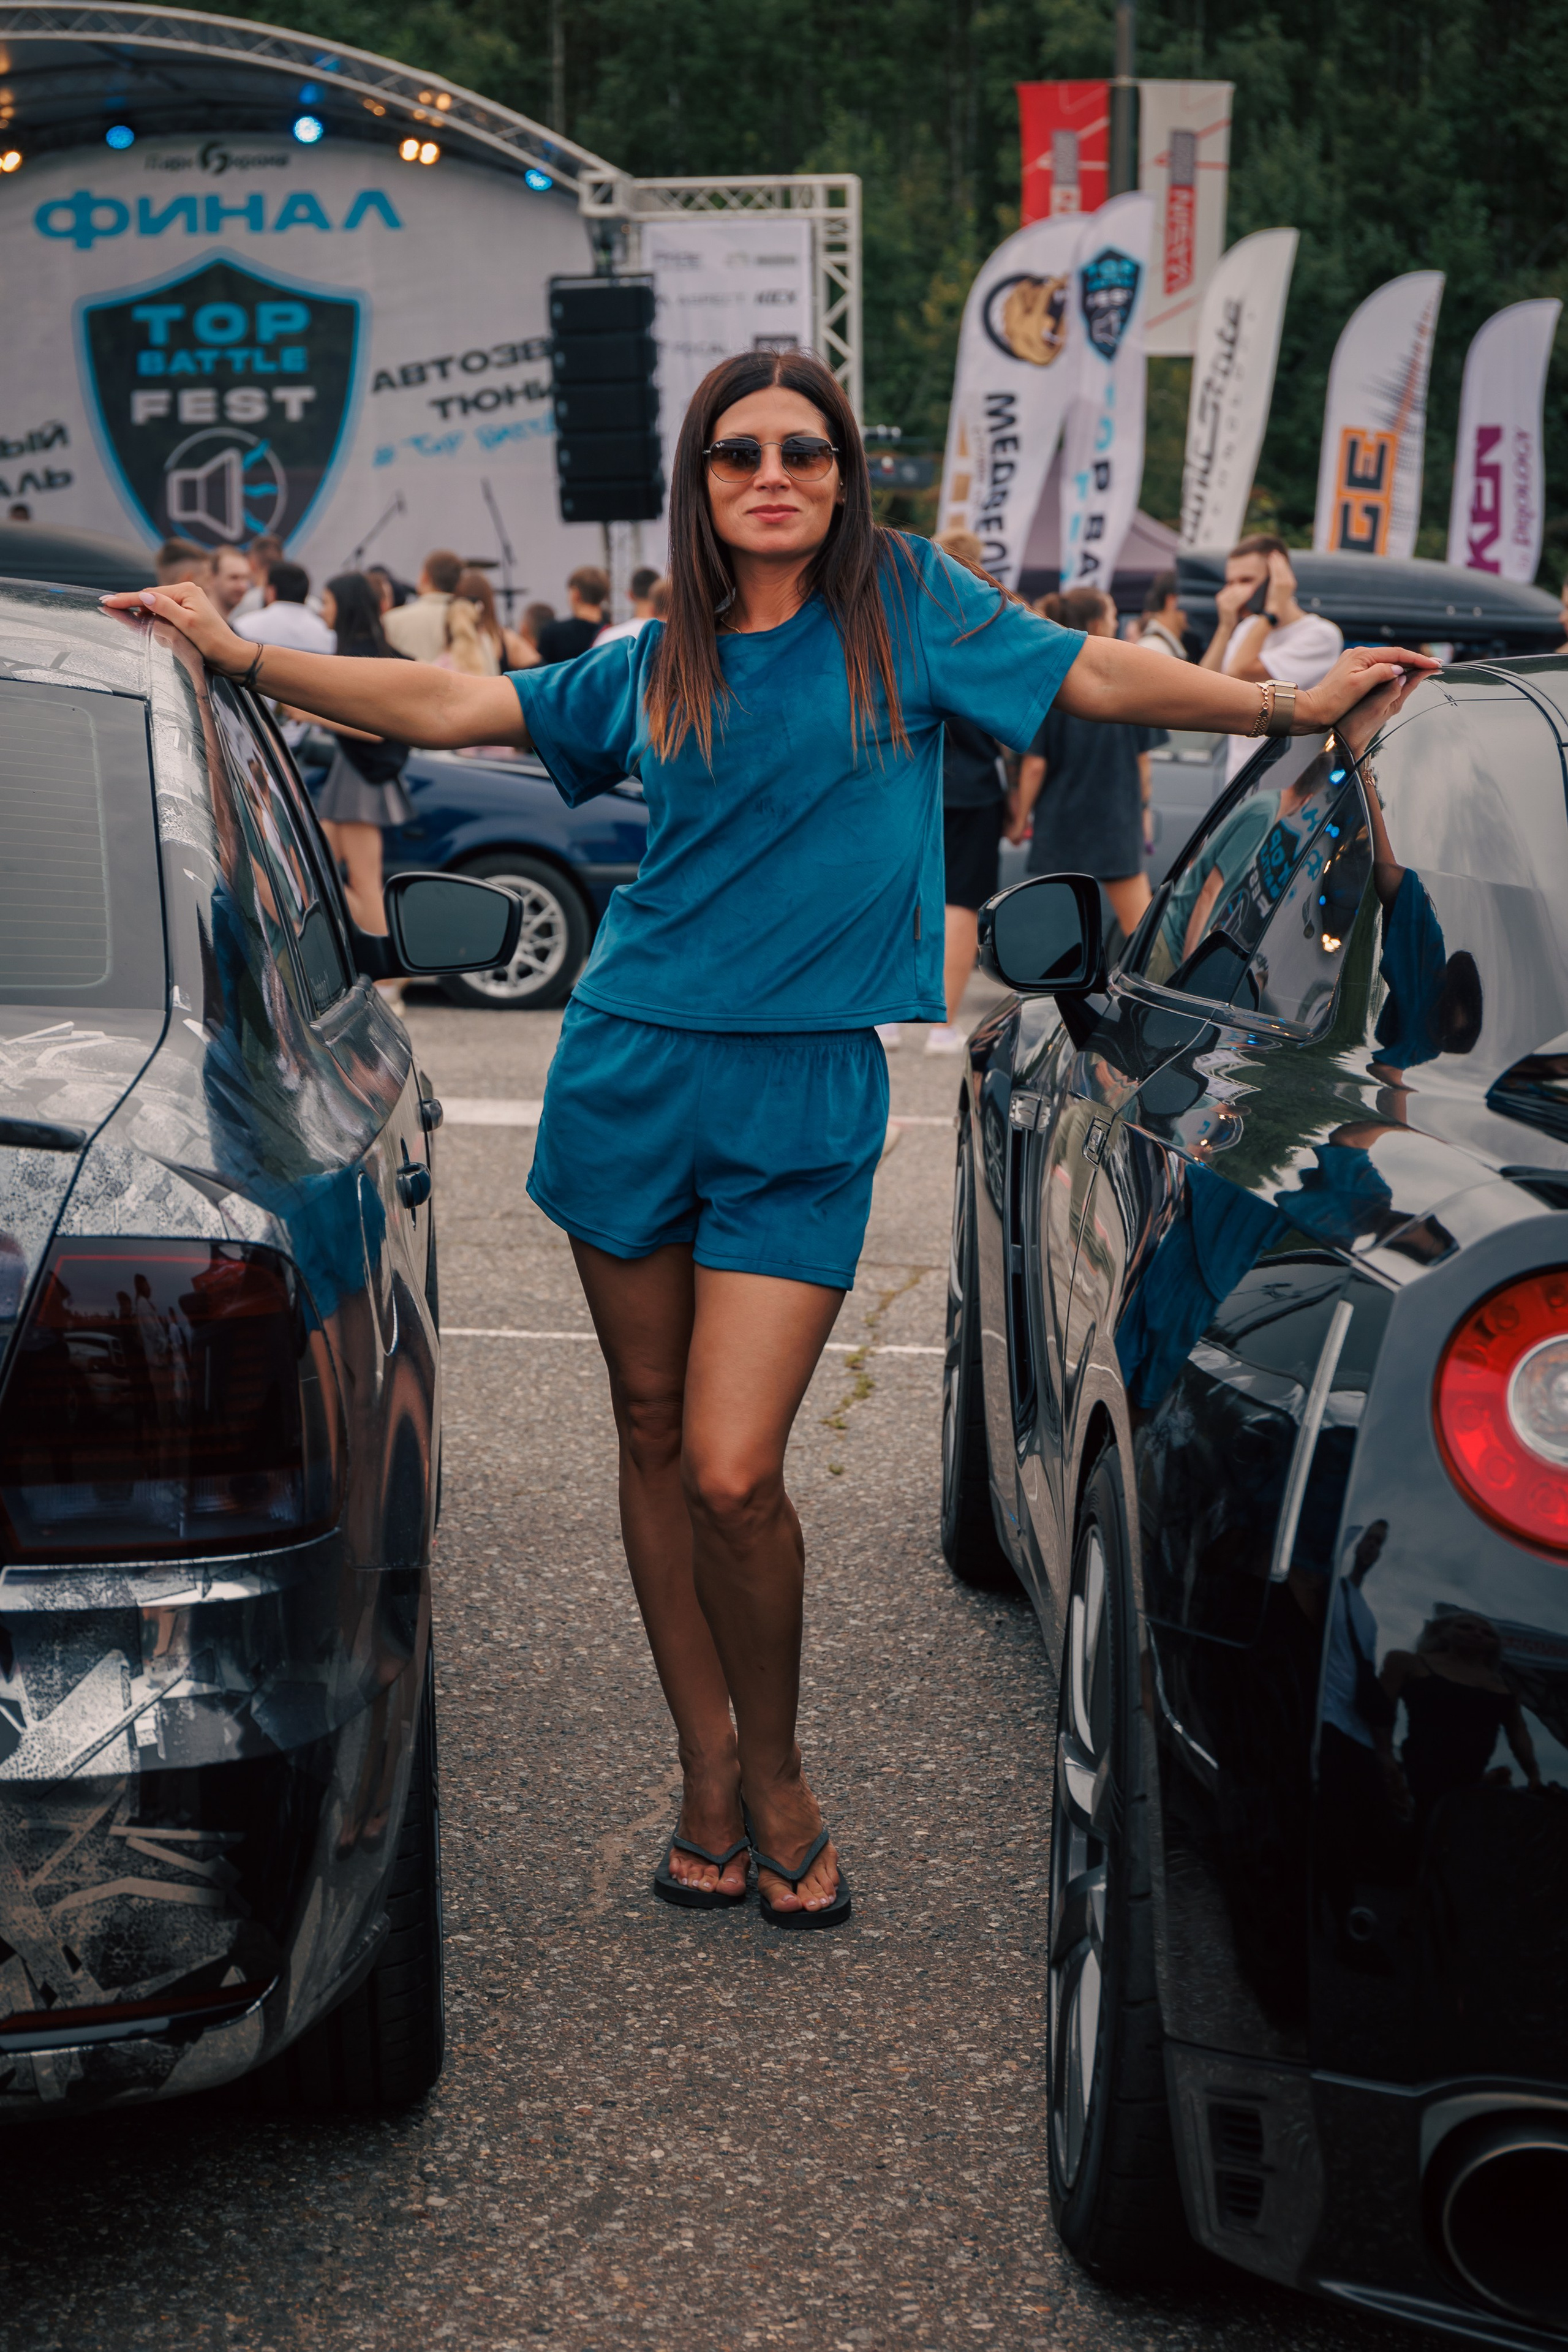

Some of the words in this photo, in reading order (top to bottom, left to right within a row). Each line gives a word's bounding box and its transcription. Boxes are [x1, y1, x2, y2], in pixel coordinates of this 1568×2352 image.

[34, 190, 402, 250] ФИНАЛ
[131, 300, 311, 345] TOP
[136, 345, 309, 376] BATTLE
[130, 385, 316, 424] FEST
